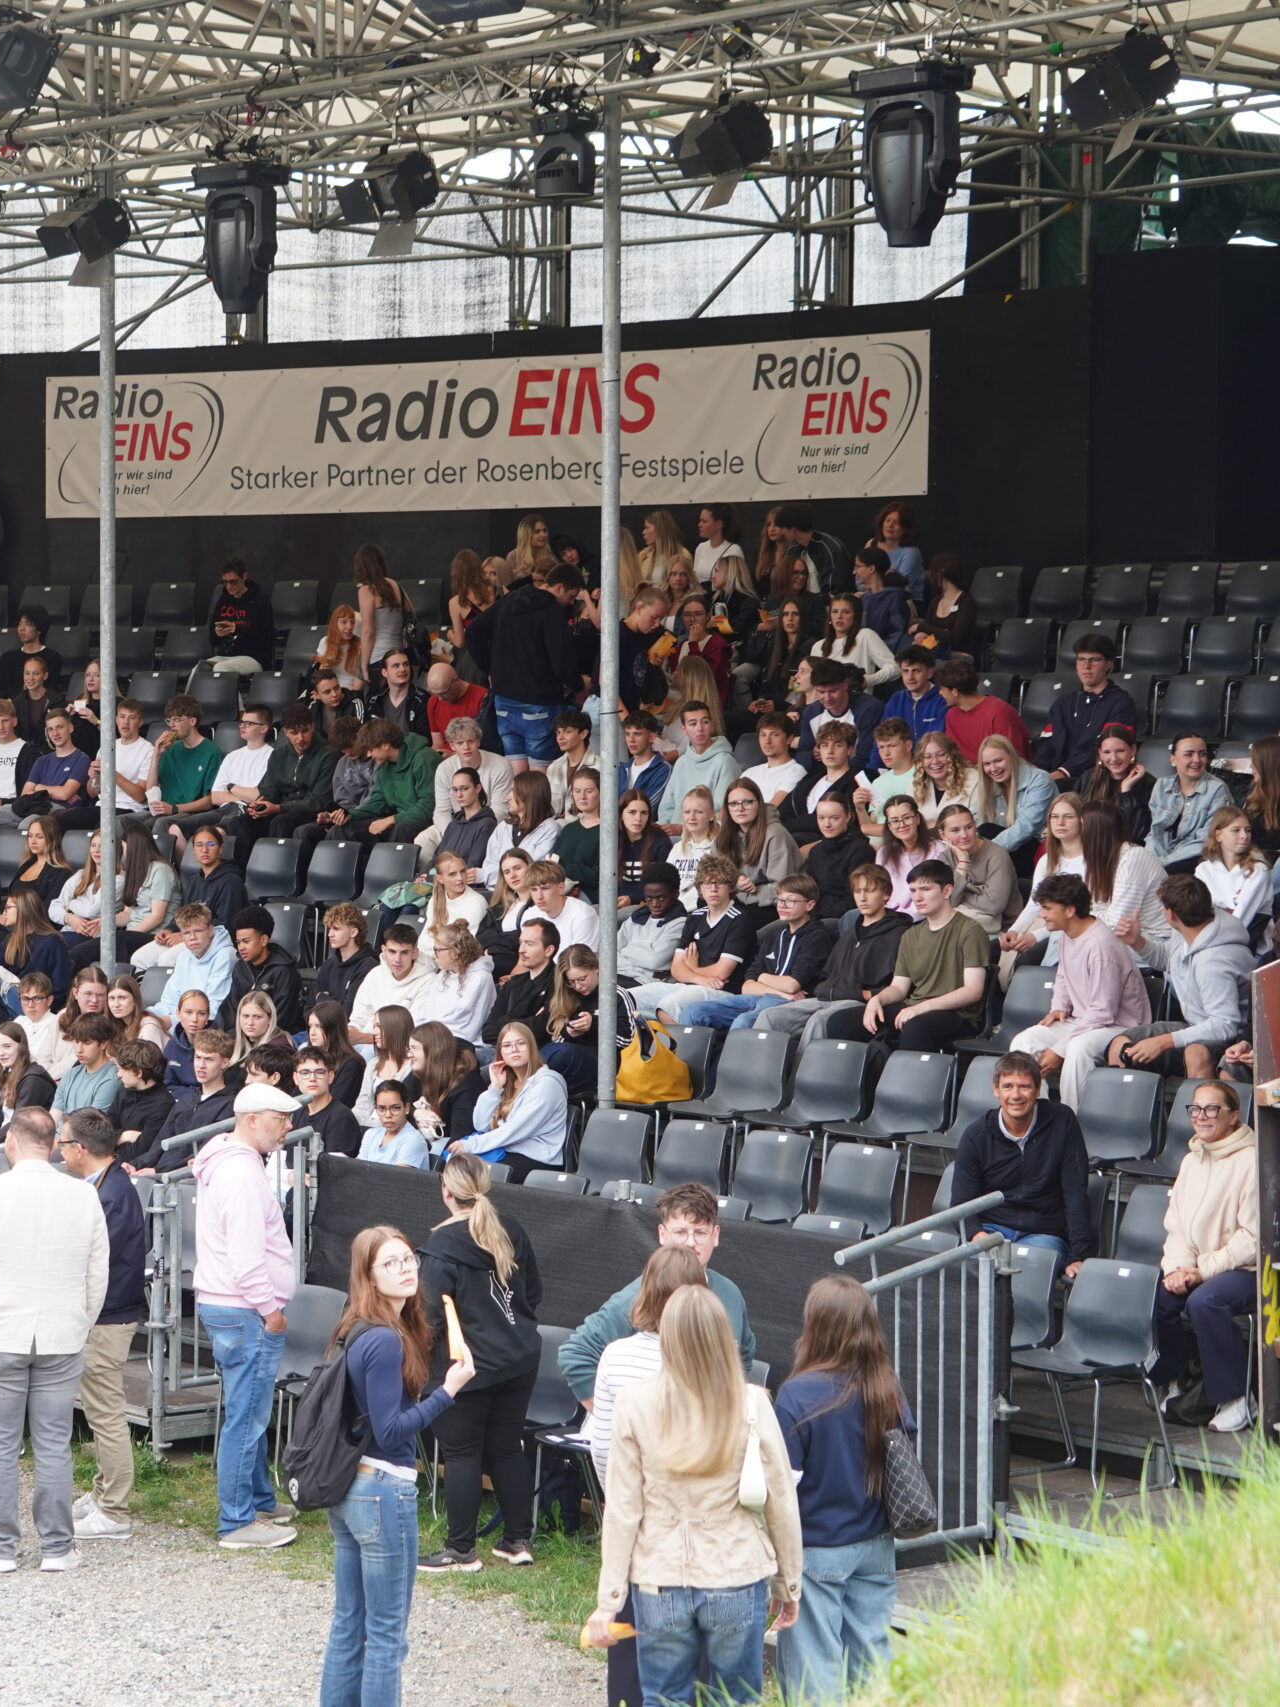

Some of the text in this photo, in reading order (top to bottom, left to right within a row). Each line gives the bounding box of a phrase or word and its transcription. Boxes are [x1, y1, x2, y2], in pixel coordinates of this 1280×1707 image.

[753, 347, 860, 391] Radio
[53, 384, 164, 419] Radio
[801, 377, 890, 436] EINS
[800, 443, 869, 458] Nur wir sind
[127, 471, 144, 480] wir
[147, 469, 173, 480] sind
[230, 465, 318, 490] Starker
[327, 463, 416, 487] Partner
[424, 460, 467, 484] der
[619, 449, 744, 482] Festspiele
[797, 461, 846, 474] von hier!
[123, 484, 150, 495] hier!
